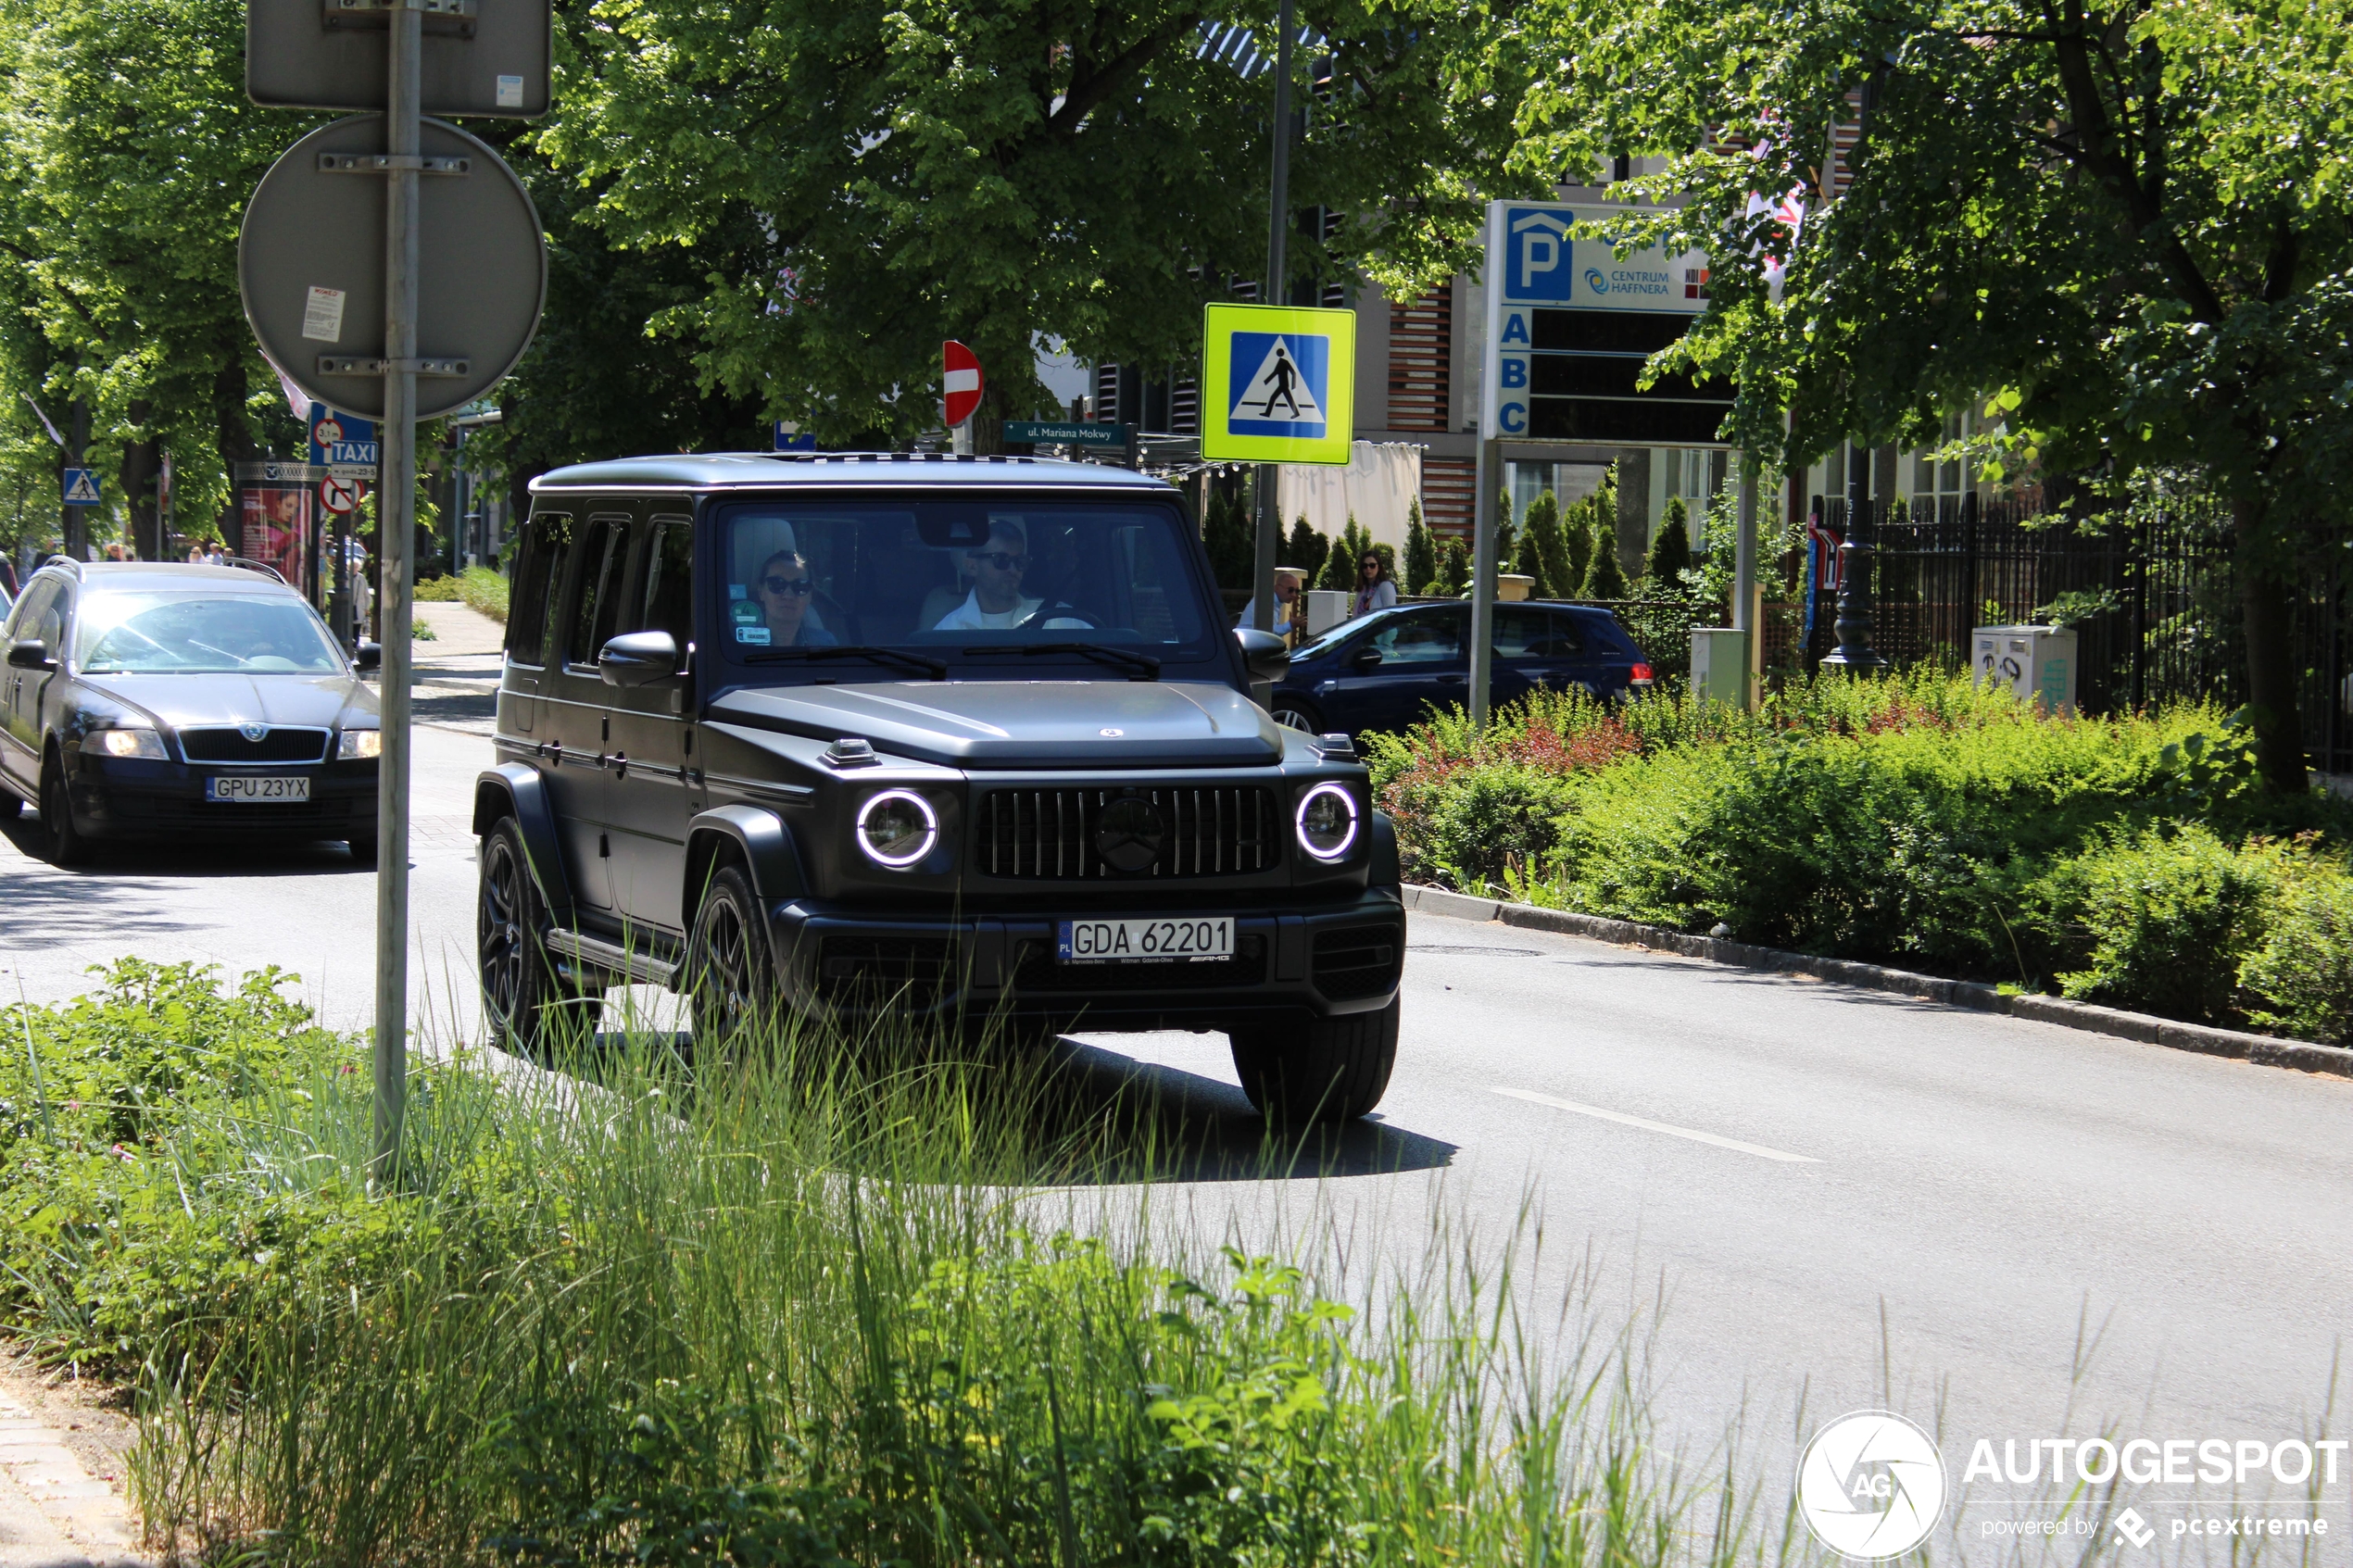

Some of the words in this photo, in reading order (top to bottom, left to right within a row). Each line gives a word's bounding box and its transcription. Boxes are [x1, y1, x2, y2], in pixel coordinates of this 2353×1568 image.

[1522, 232, 1559, 287] P
[1611, 270, 1668, 283] CENTRUM
[1685, 269, 1699, 283] NDI
[1611, 283, 1668, 295] HAFFNERA
[1501, 313, 1530, 344] A
[1501, 358, 1528, 388] B
[1499, 402, 1527, 433] C
[1027, 427, 1039, 437] ul.
[1041, 427, 1077, 438] Mariana
[1079, 429, 1112, 441] Mokwy
[333, 443, 376, 462] TAXI
[358, 468, 375, 476] 23-5
[218, 779, 257, 797] GPU
[263, 779, 308, 797] 23YX
[1075, 923, 1130, 954] GDA
[1141, 921, 1227, 953] 62201
[1060, 944, 1071, 953] PL
